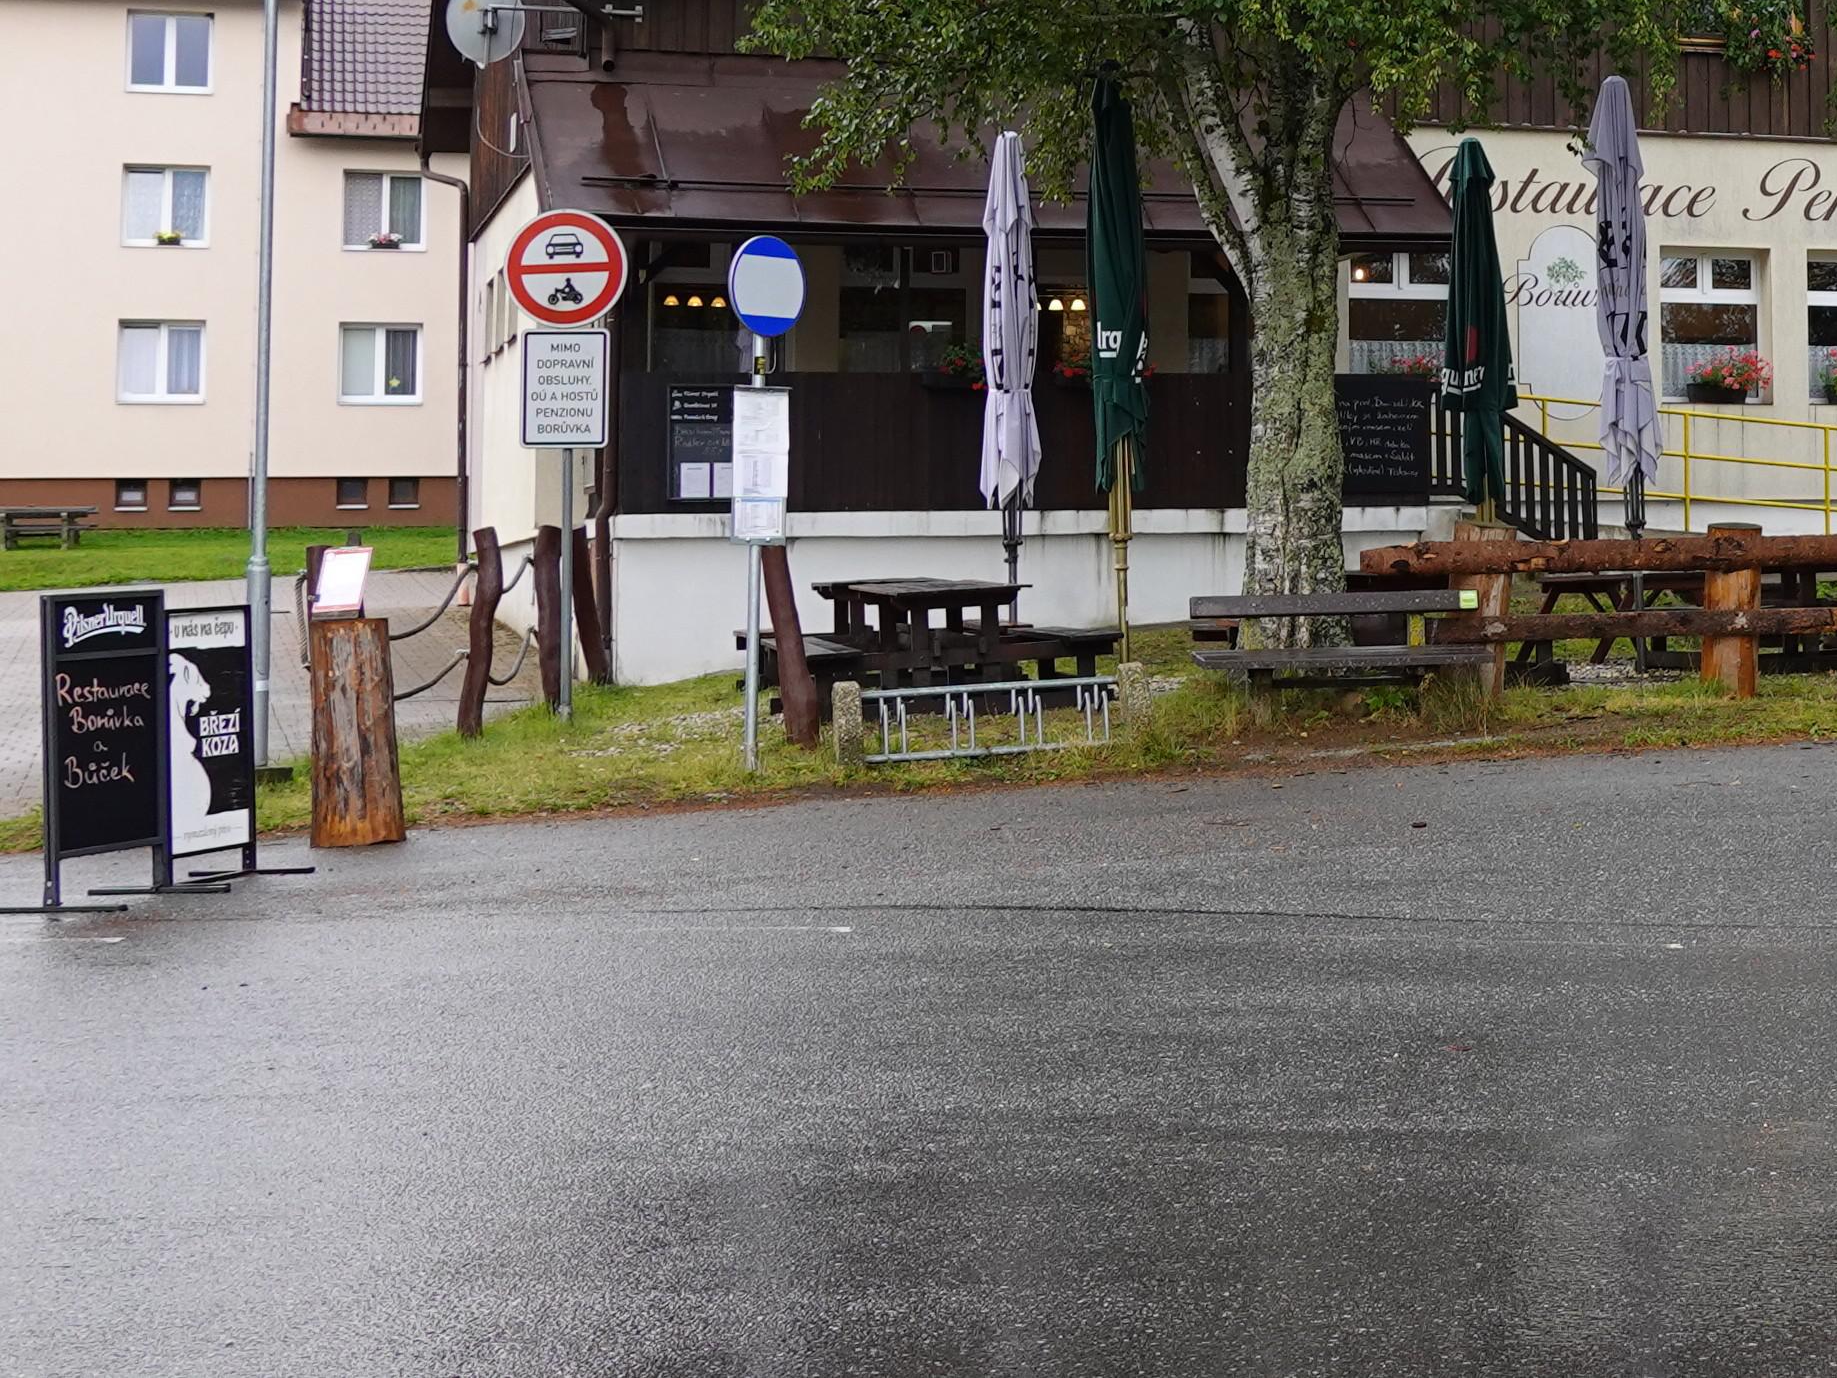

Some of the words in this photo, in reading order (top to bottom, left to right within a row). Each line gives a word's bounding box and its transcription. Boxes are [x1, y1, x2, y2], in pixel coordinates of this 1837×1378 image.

[1419, 145, 1717, 218] stauace
[550, 343, 581, 353] MIMO
[536, 357, 595, 369] DOPRAVNÍ
[530, 389, 547, 401] OÚ
[550, 391, 558, 401] A
[560, 388, 598, 401] HOSTŮ
[535, 407, 593, 418] PENZIONU
[537, 421, 592, 434] BORŮVKA
[62, 605, 107, 648] Pilsner
[102, 602, 147, 635] Urquell
[182, 620, 199, 638] nás
[200, 622, 213, 637] na
[214, 616, 235, 639] čepu
[69, 706, 145, 734] Borůvka
[199, 707, 241, 736] BŘEZÍ
[93, 739, 109, 752] a
[202, 734, 240, 758] KOZA
[64, 752, 135, 789] Bůček
